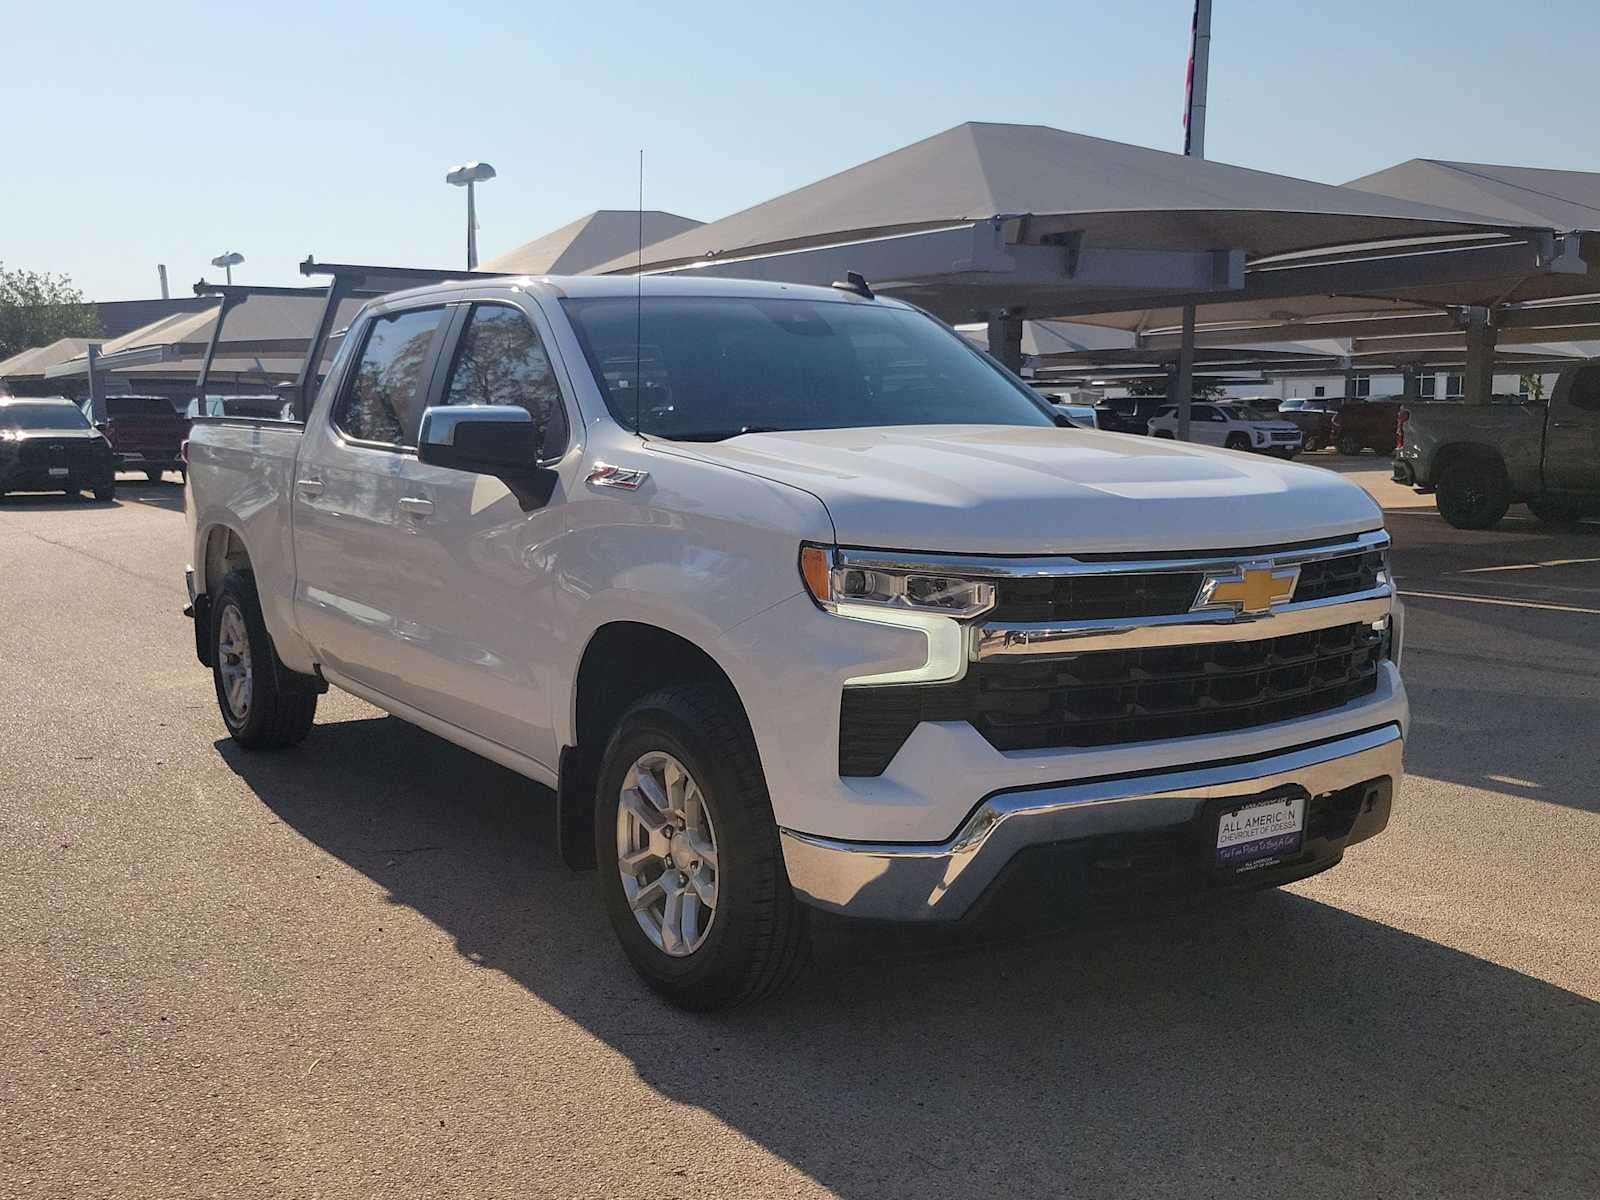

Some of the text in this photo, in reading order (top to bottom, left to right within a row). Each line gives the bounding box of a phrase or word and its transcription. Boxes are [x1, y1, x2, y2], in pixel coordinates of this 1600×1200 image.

[1222, 809, 1295, 833] ALL AMERICN
[1220, 827, 1258, 842] CHEVROLET
[1260, 825, 1270, 835] OF
